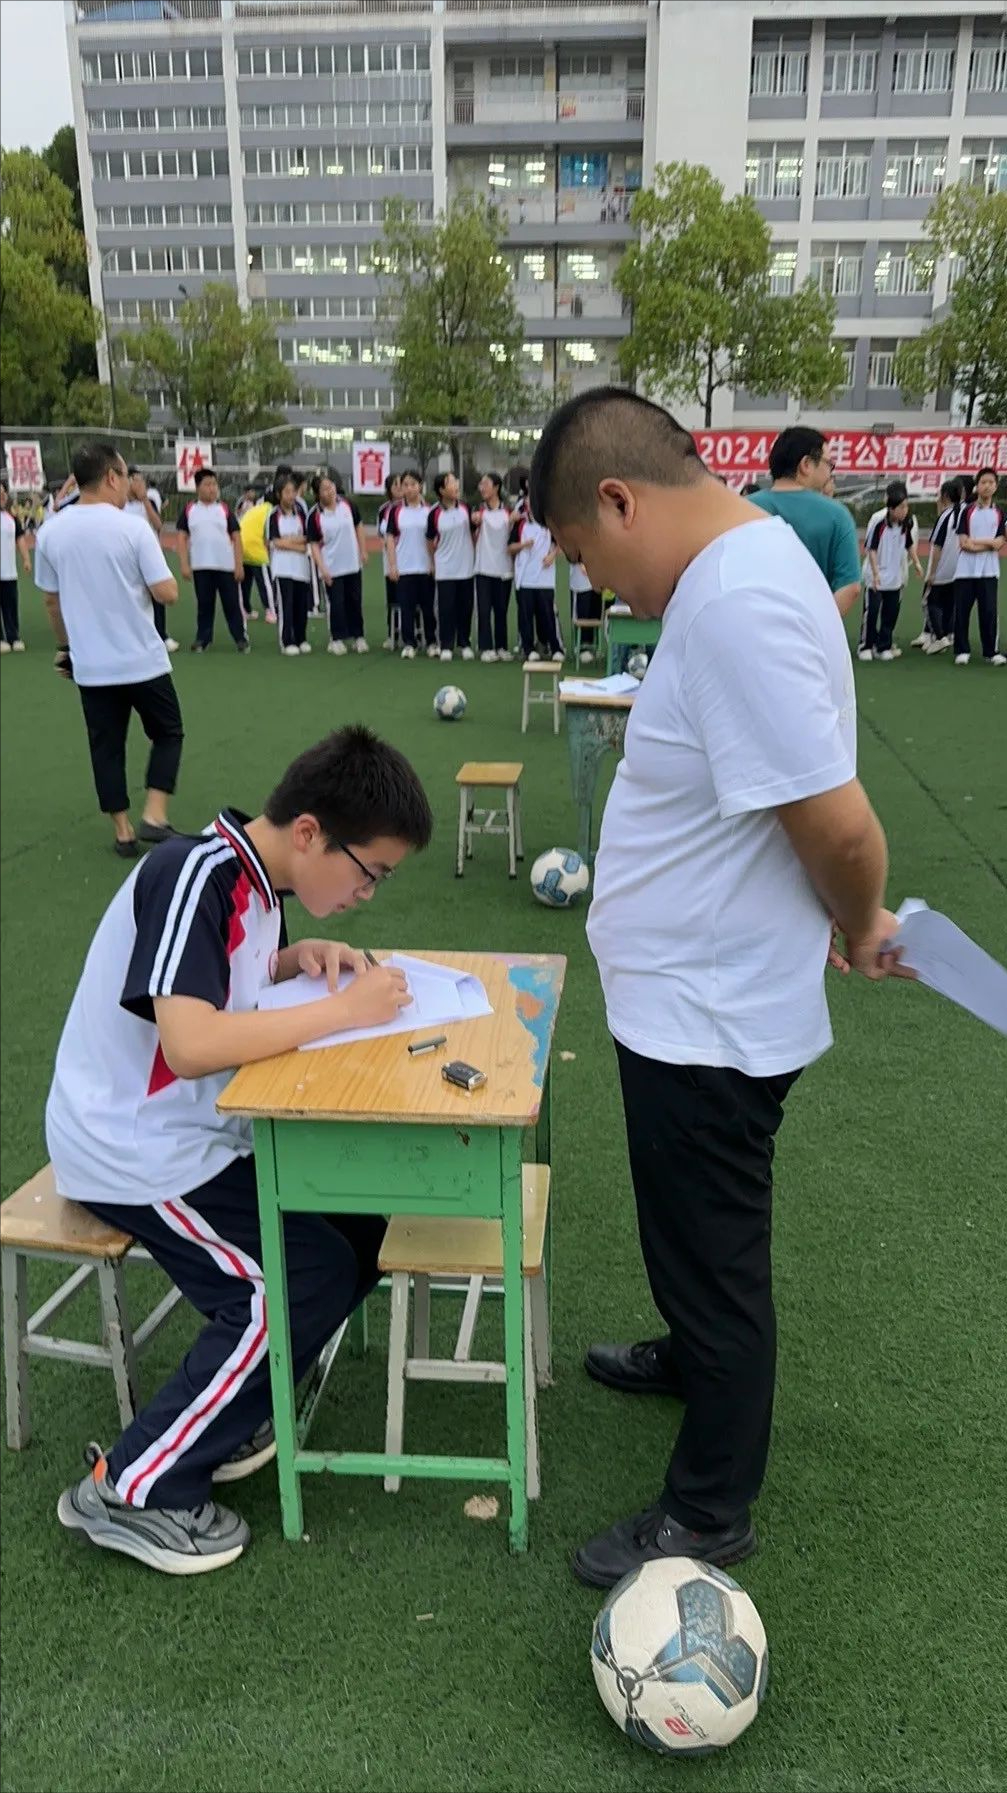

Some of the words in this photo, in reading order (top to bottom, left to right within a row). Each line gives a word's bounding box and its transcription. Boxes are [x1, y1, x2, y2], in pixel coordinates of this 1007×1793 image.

[358, 448, 385, 487] 育
[699, 434, 1007, 468] 2024生公寓应急疏
